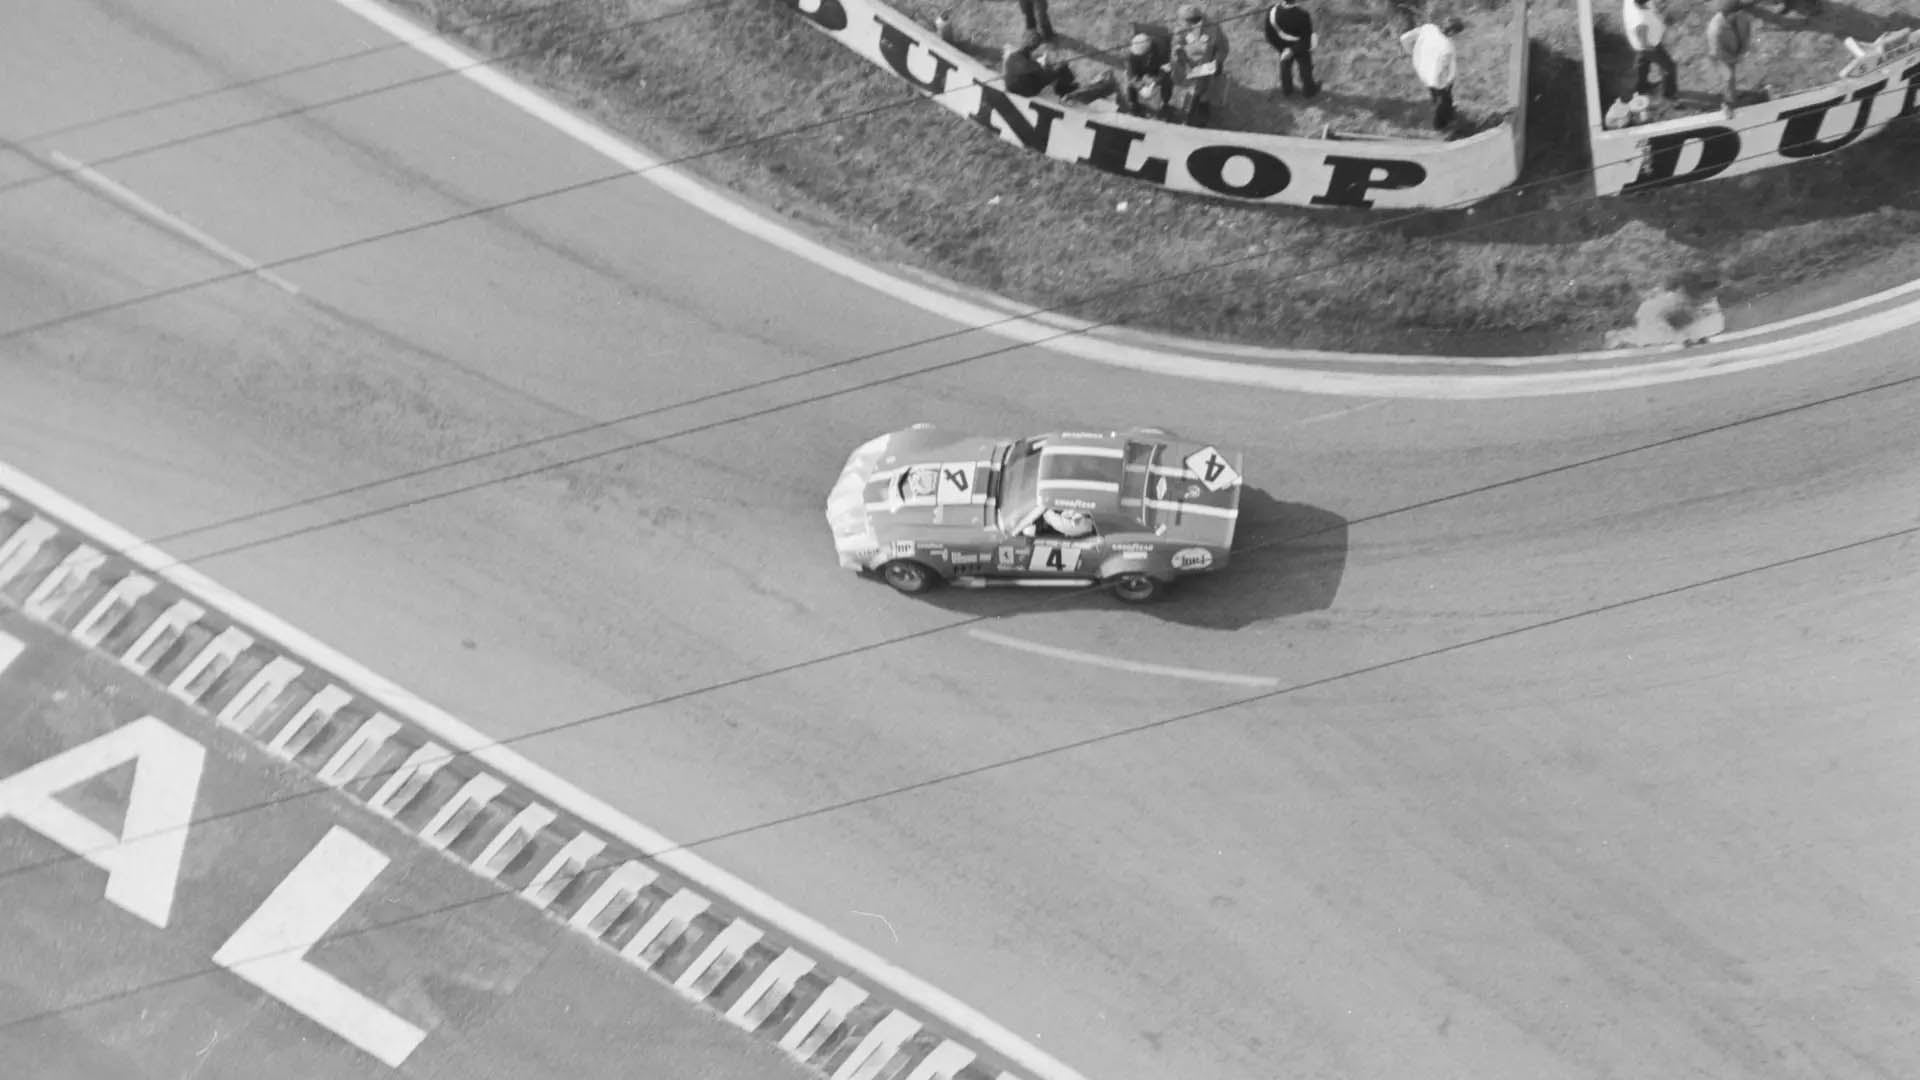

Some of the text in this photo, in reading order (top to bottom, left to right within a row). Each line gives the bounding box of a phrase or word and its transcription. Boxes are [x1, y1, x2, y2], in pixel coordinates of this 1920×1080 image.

[1620, 62, 1920, 196] DU
[943, 469, 968, 491] 4
[1205, 454, 1225, 482] 4
[1046, 548, 1067, 571] 4
[0, 631, 428, 1068] AL
